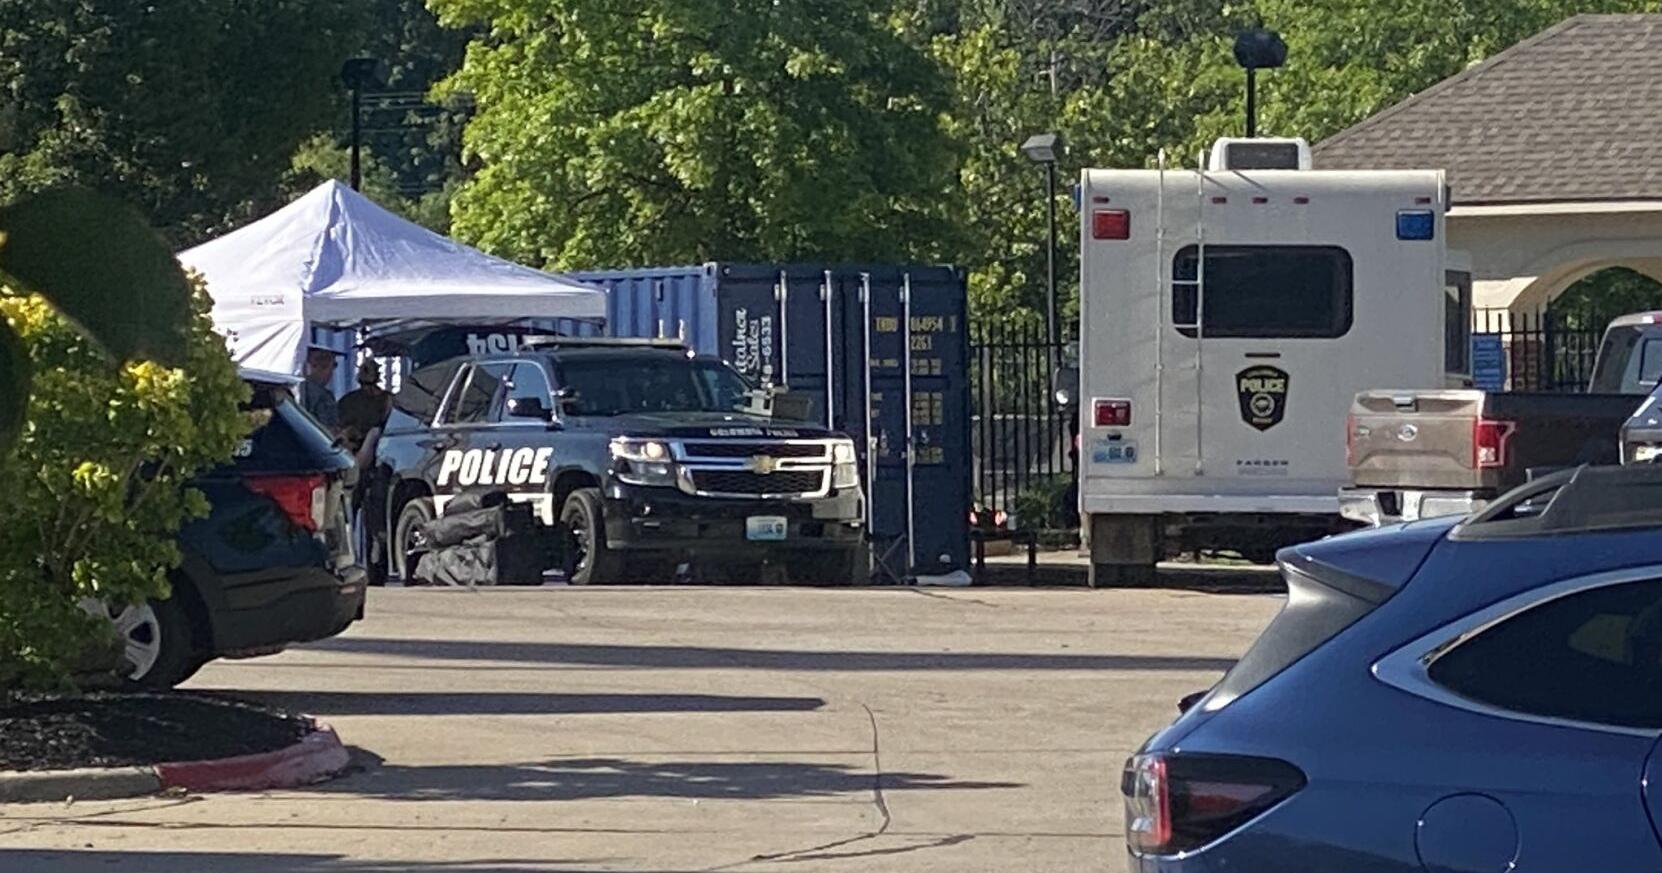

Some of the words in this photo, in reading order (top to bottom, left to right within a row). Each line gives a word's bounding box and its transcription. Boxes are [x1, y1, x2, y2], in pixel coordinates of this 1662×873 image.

[732, 307, 747, 373] tainer
[1241, 378, 1285, 393] POLICE
[436, 447, 554, 486] POLICE
